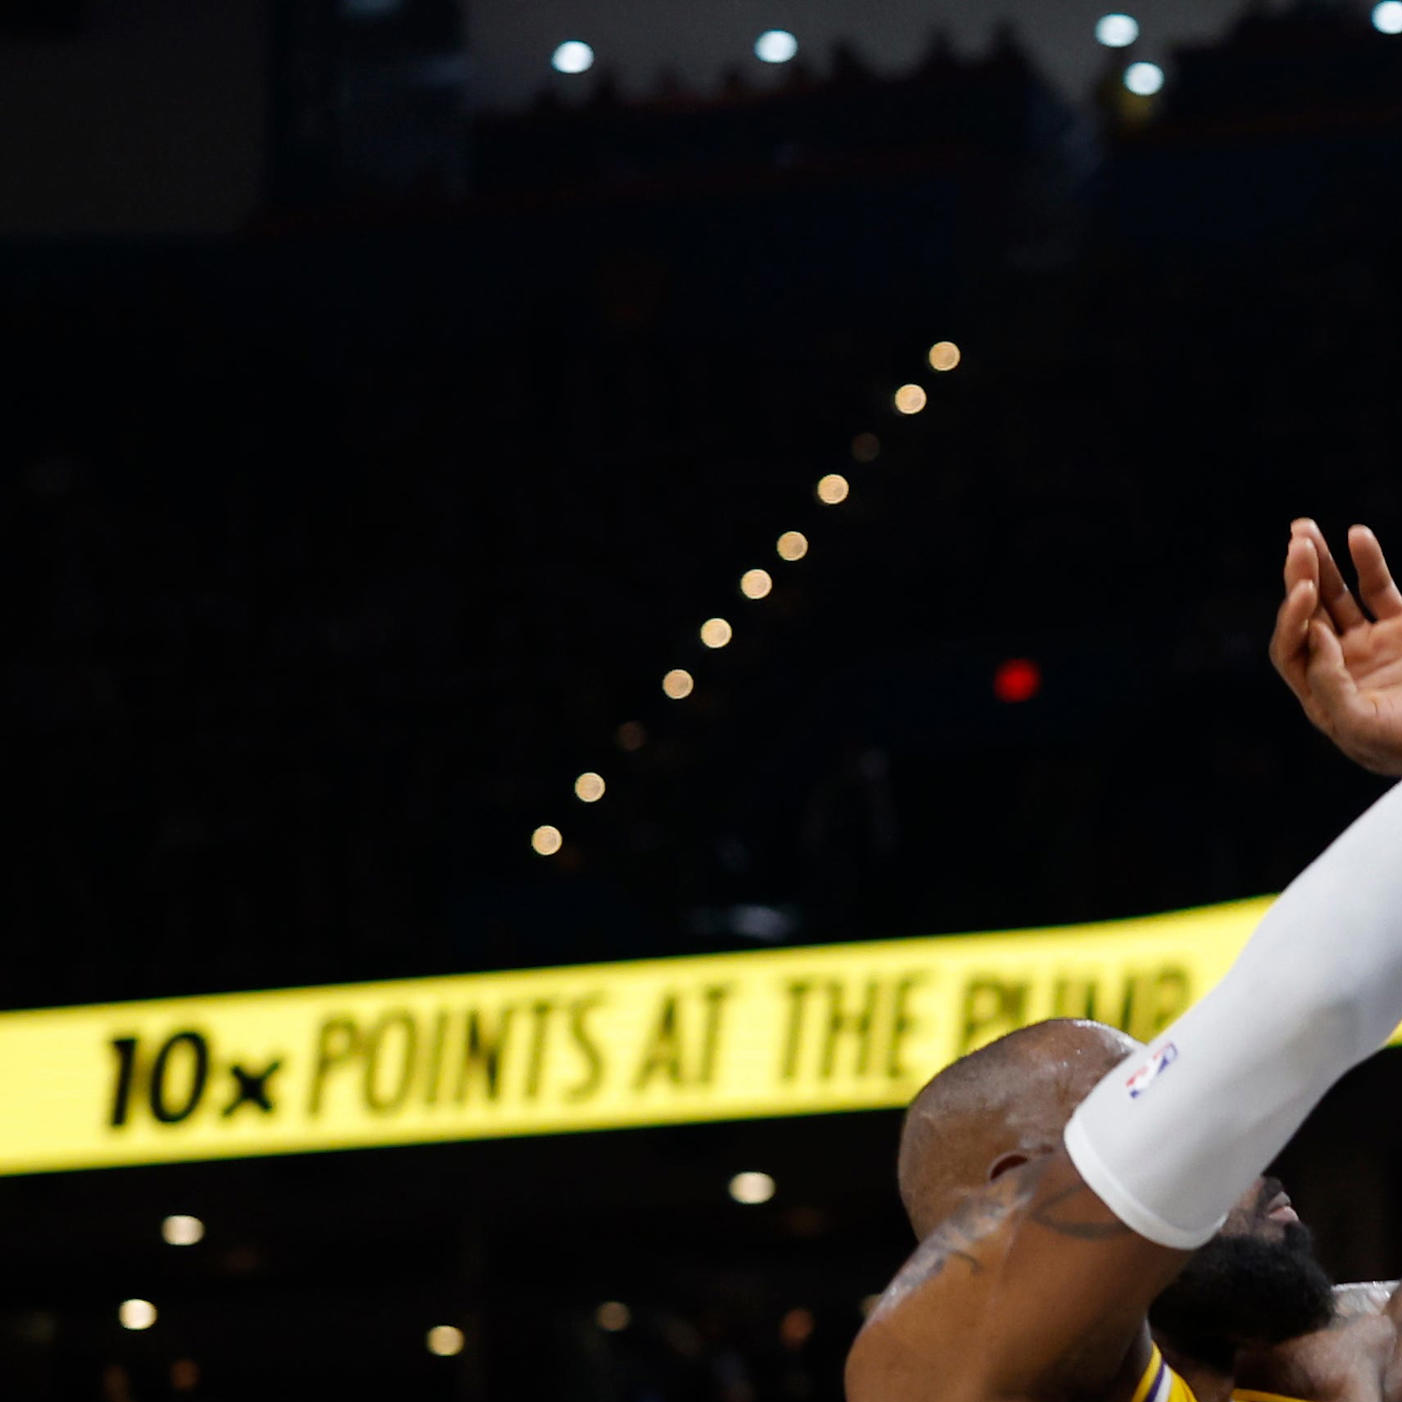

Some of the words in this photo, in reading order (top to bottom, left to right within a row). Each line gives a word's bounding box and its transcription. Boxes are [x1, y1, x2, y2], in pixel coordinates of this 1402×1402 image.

[106, 1031, 282, 1127] 10x
[306, 1003, 606, 1118] POINTS
[632, 985, 735, 1090] AT
[781, 973, 932, 1083] THE
